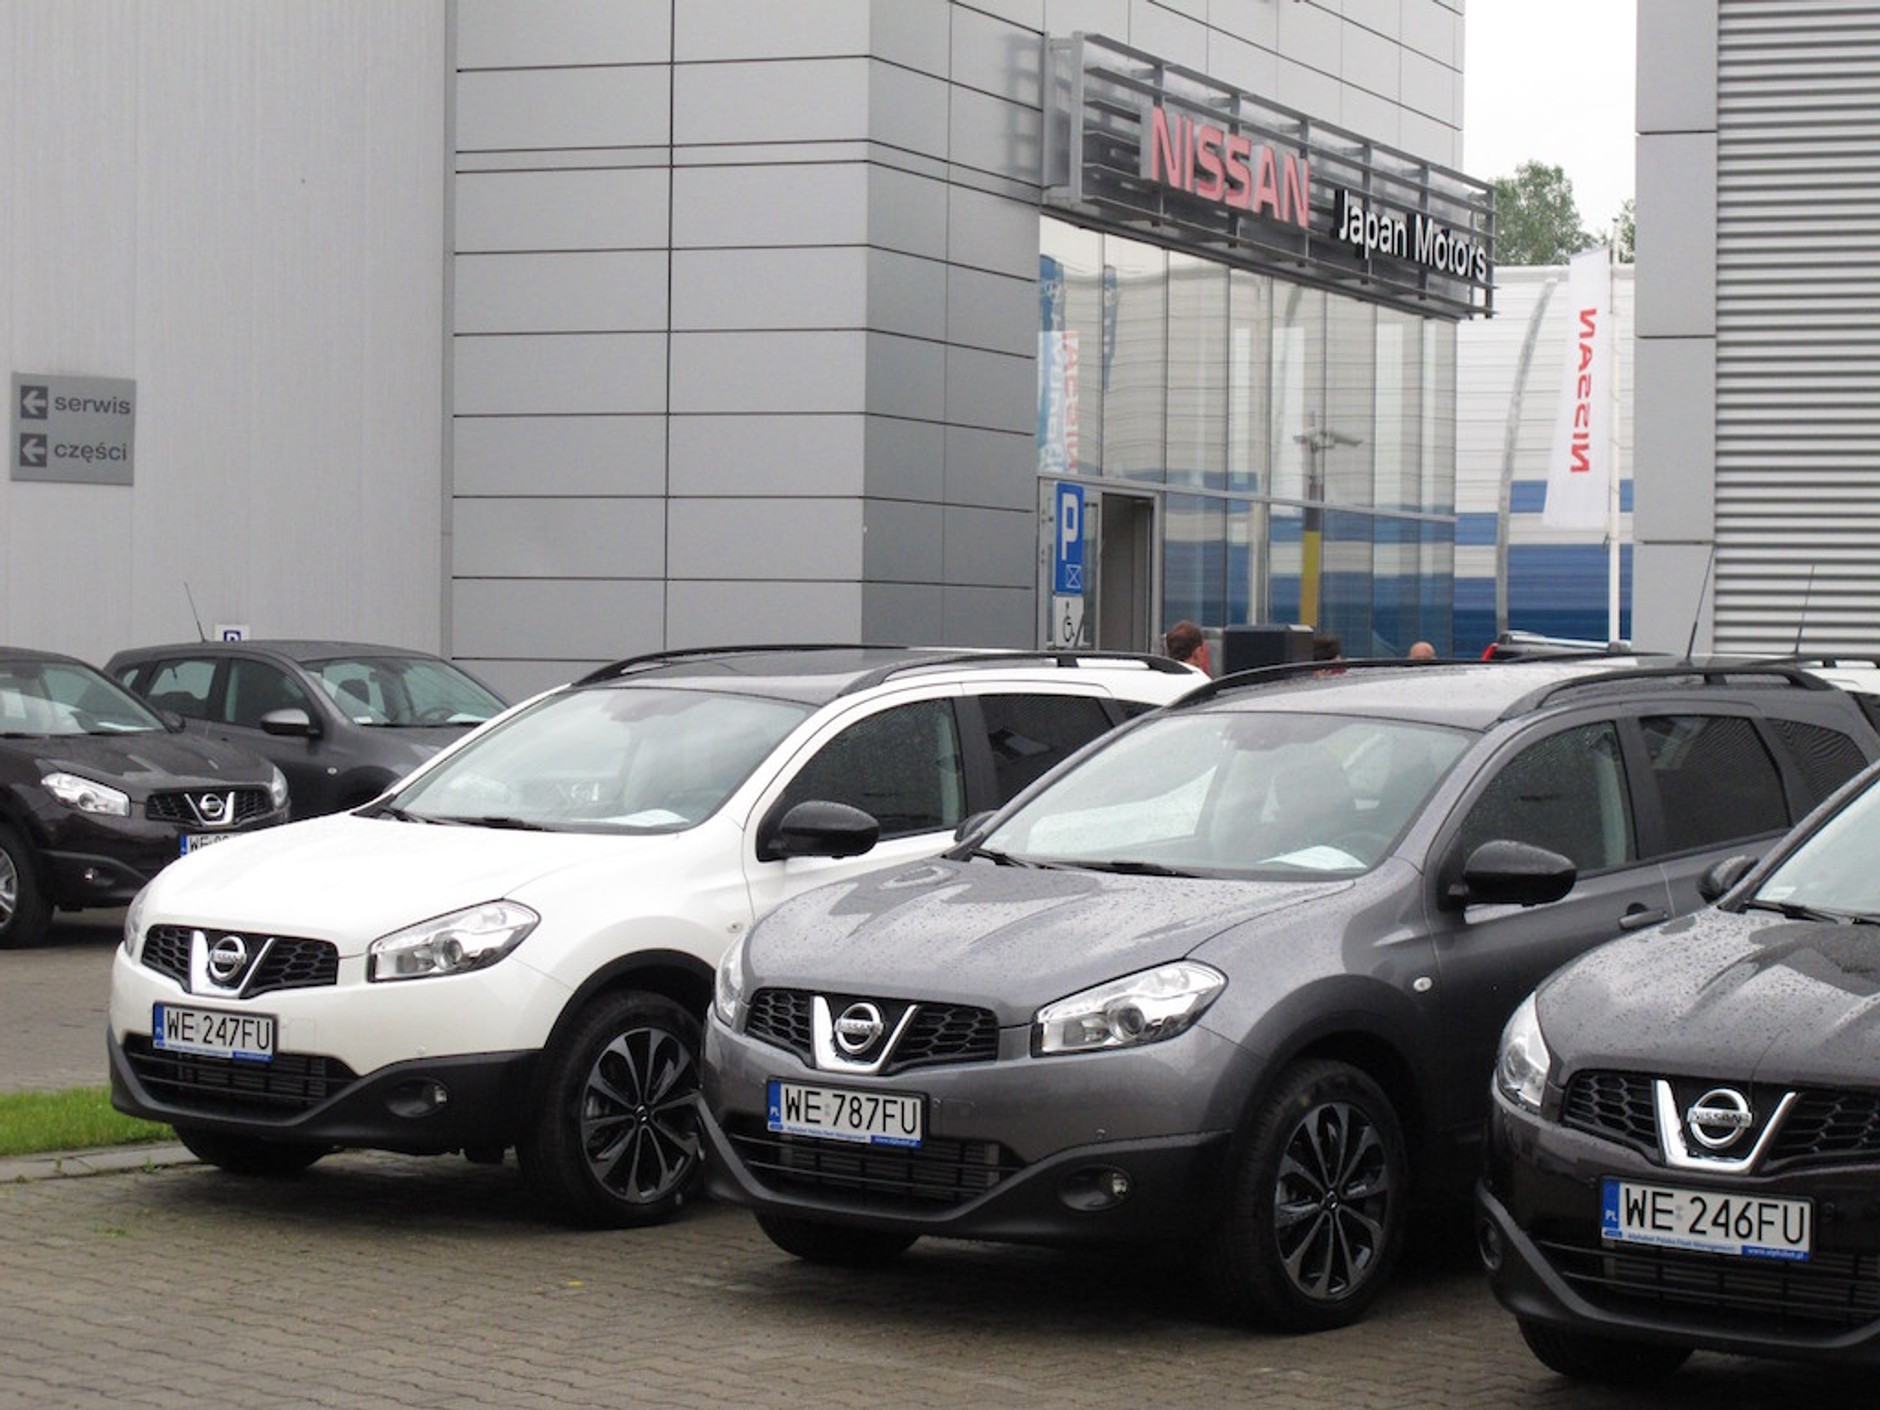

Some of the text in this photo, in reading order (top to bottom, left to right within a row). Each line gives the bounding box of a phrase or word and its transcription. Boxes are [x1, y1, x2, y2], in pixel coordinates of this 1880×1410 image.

[1149, 104, 1311, 229] NISSAN
[1338, 189, 1487, 283] Japan Motors
[54, 396, 131, 415] serwis
[54, 441, 127, 463] części
[1061, 492, 1079, 561] P
[166, 1010, 270, 1050] WE 247FU
[785, 1088, 917, 1135] WE 787FU
[1605, 1210, 1618, 1222] PL
[1625, 1187, 1805, 1245] WE 246FU
